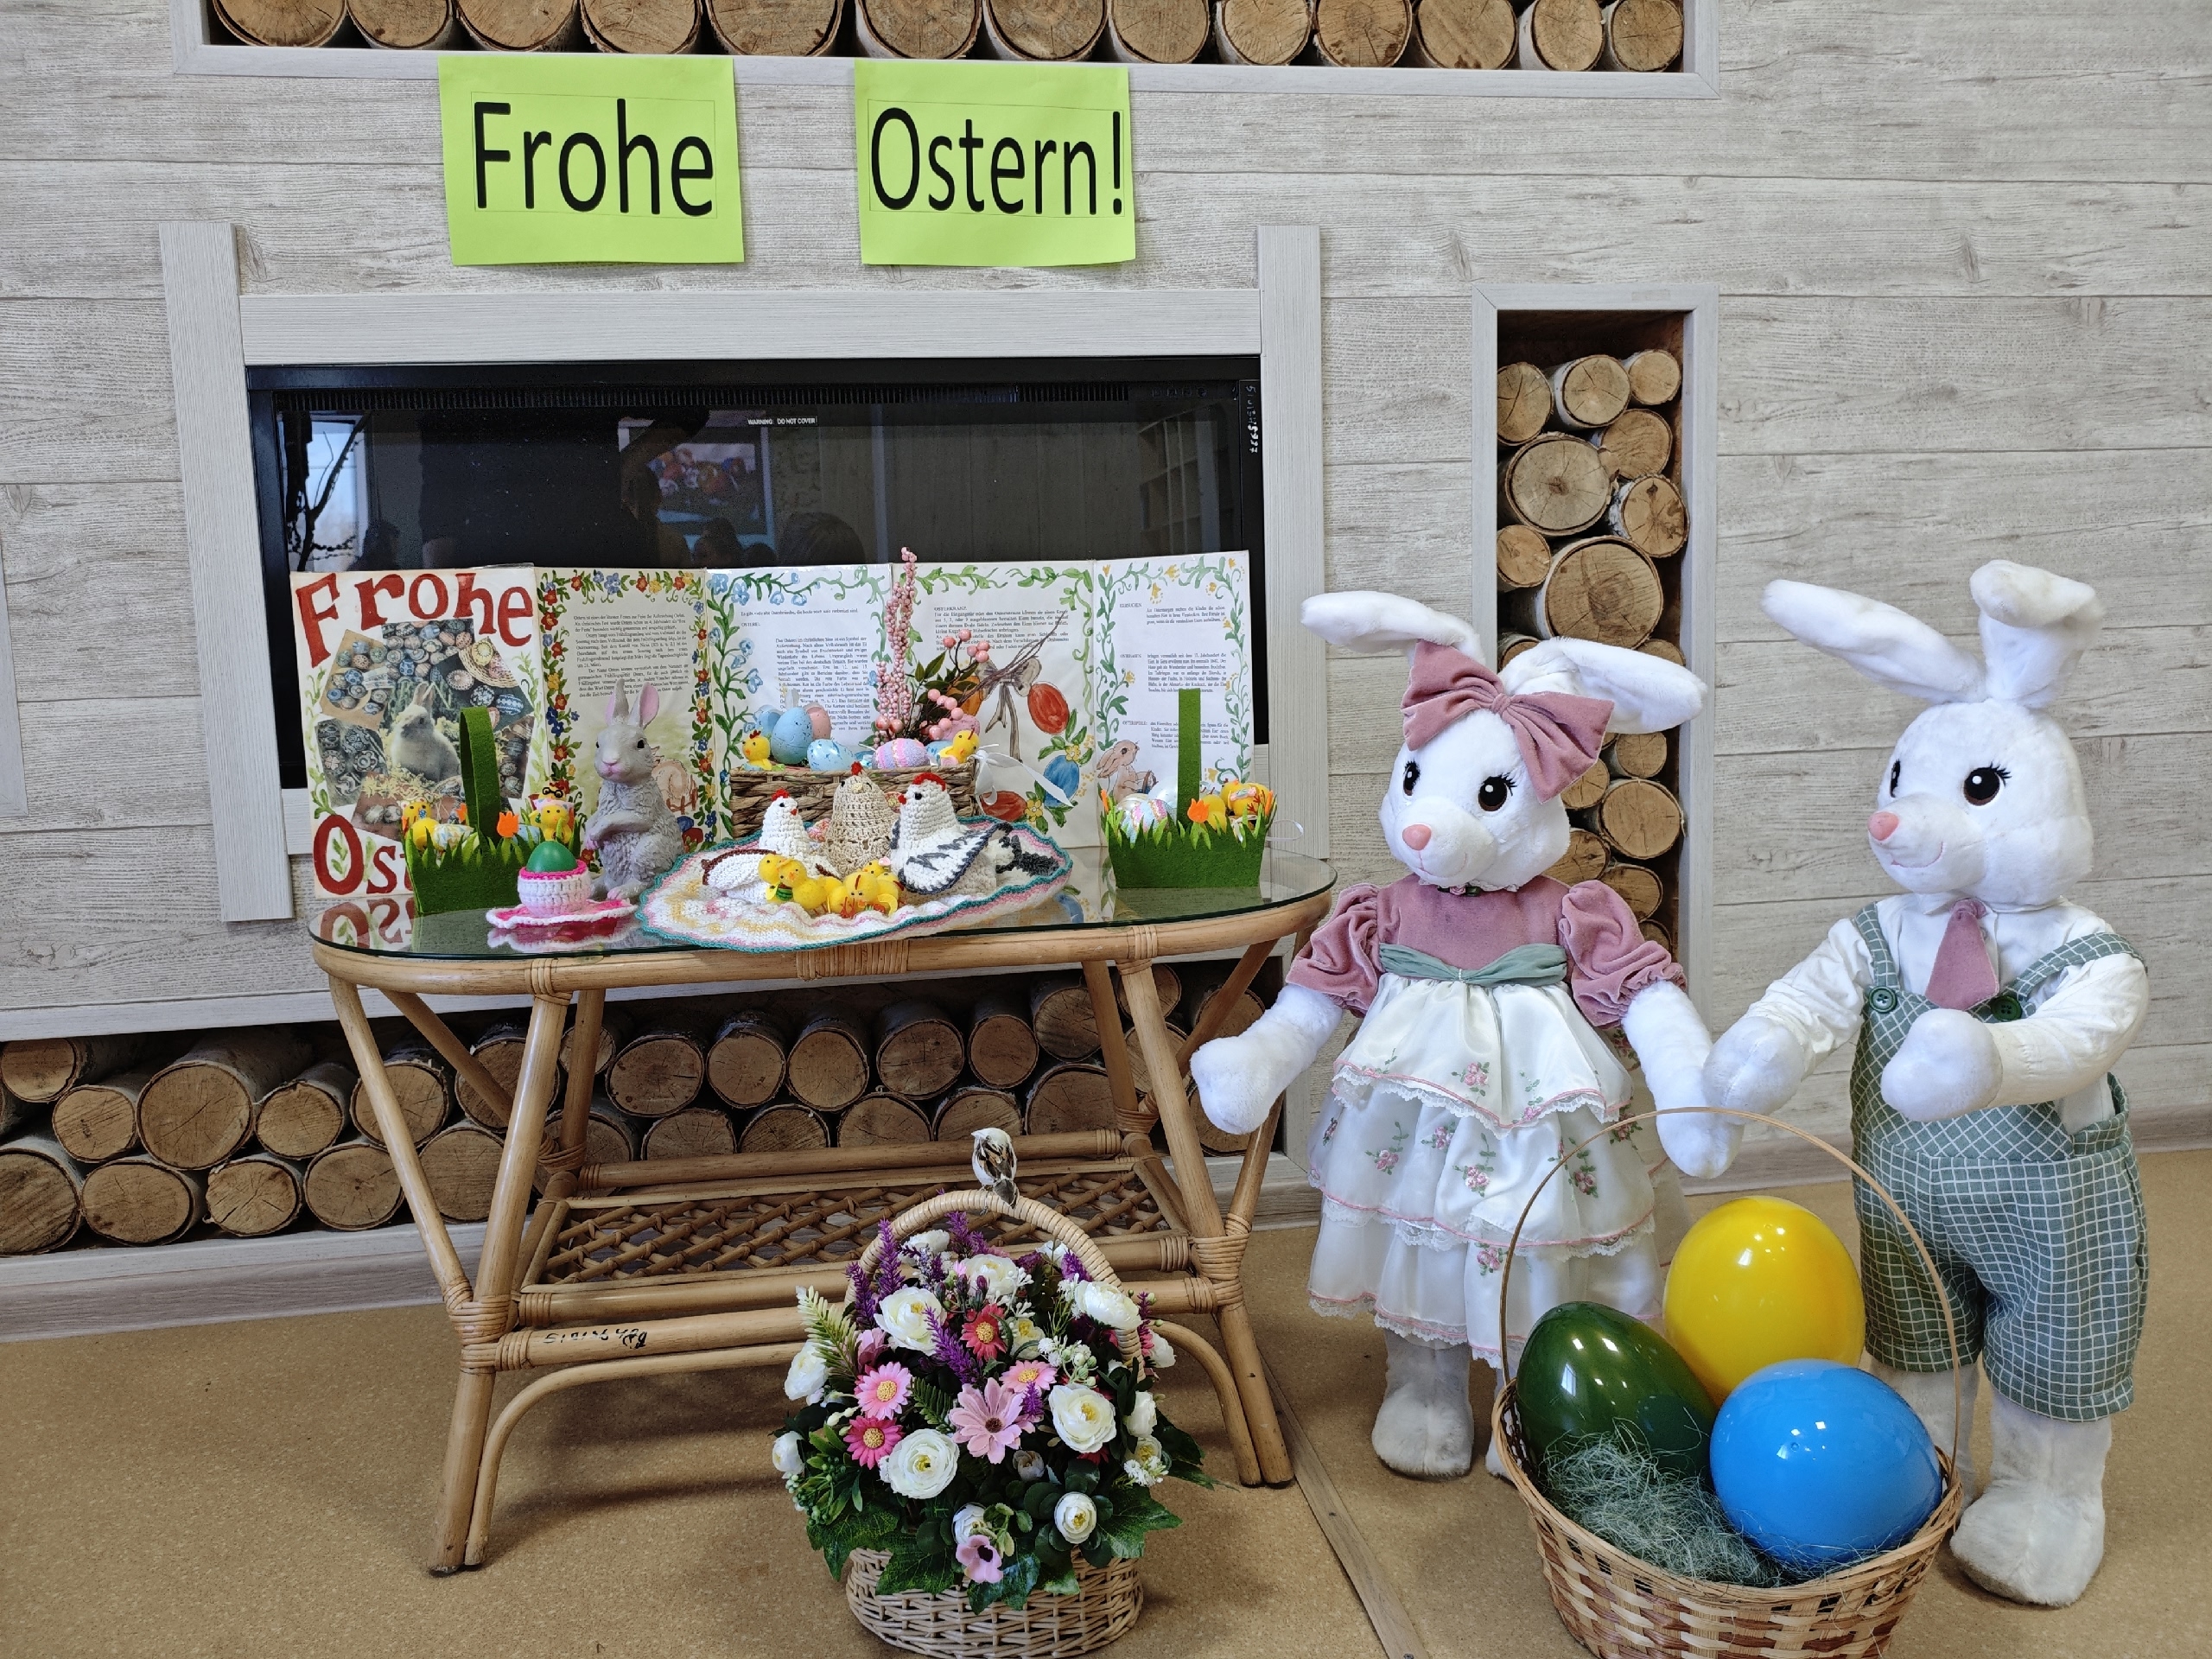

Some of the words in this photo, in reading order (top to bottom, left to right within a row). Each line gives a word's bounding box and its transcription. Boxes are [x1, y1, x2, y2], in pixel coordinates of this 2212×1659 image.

[473, 99, 714, 216] Frohe
[870, 107, 1122, 215] Ostern!
[296, 573, 534, 668] Frohe
